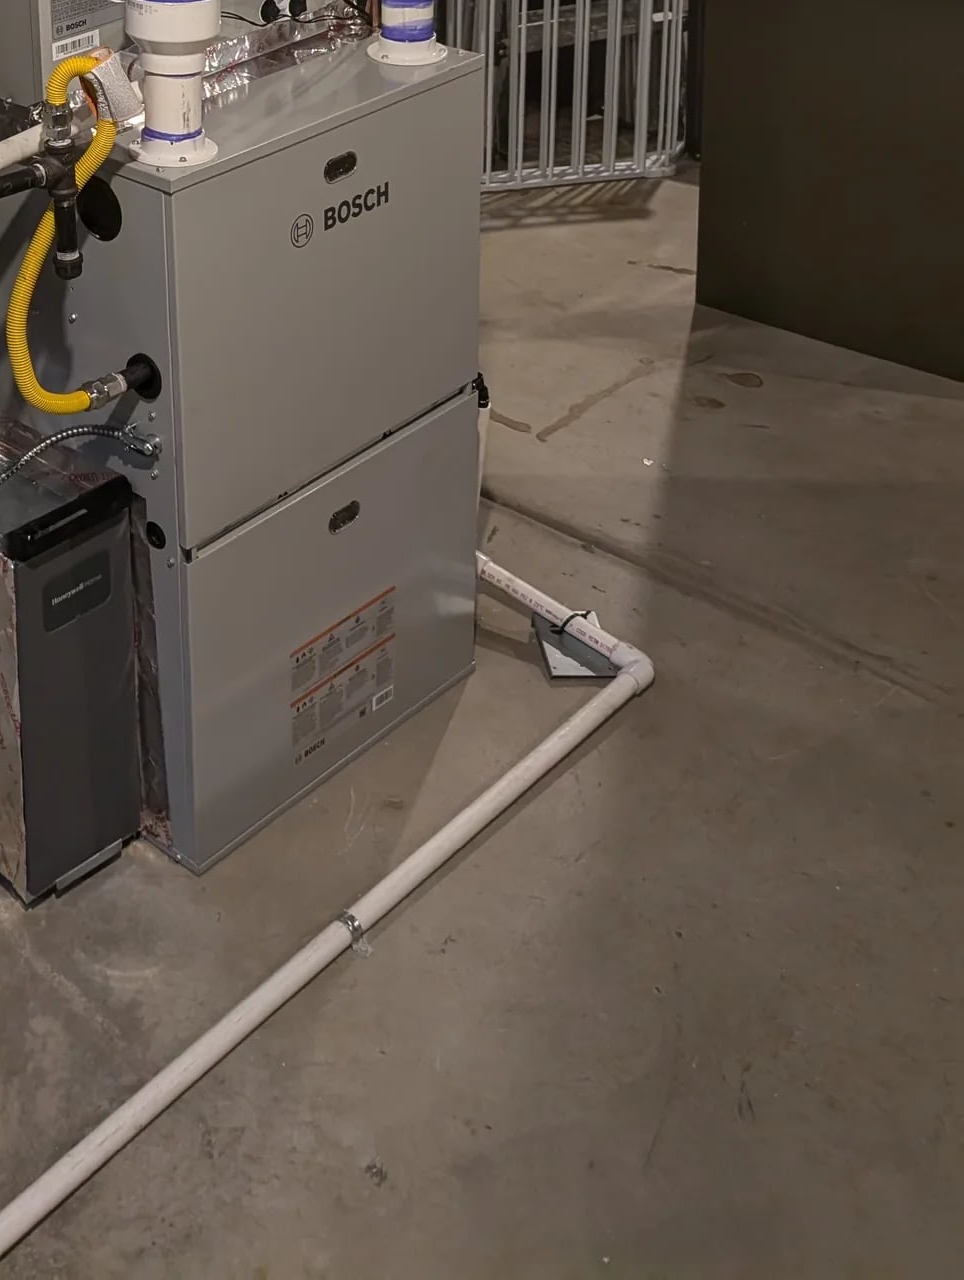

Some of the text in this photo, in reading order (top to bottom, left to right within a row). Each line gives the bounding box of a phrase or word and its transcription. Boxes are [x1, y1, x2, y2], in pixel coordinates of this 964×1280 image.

[66, 19, 87, 31] BOSCH
[324, 181, 389, 231] BOSCH
[52, 583, 84, 606] Honeywell
[304, 736, 325, 758] BOSCH
